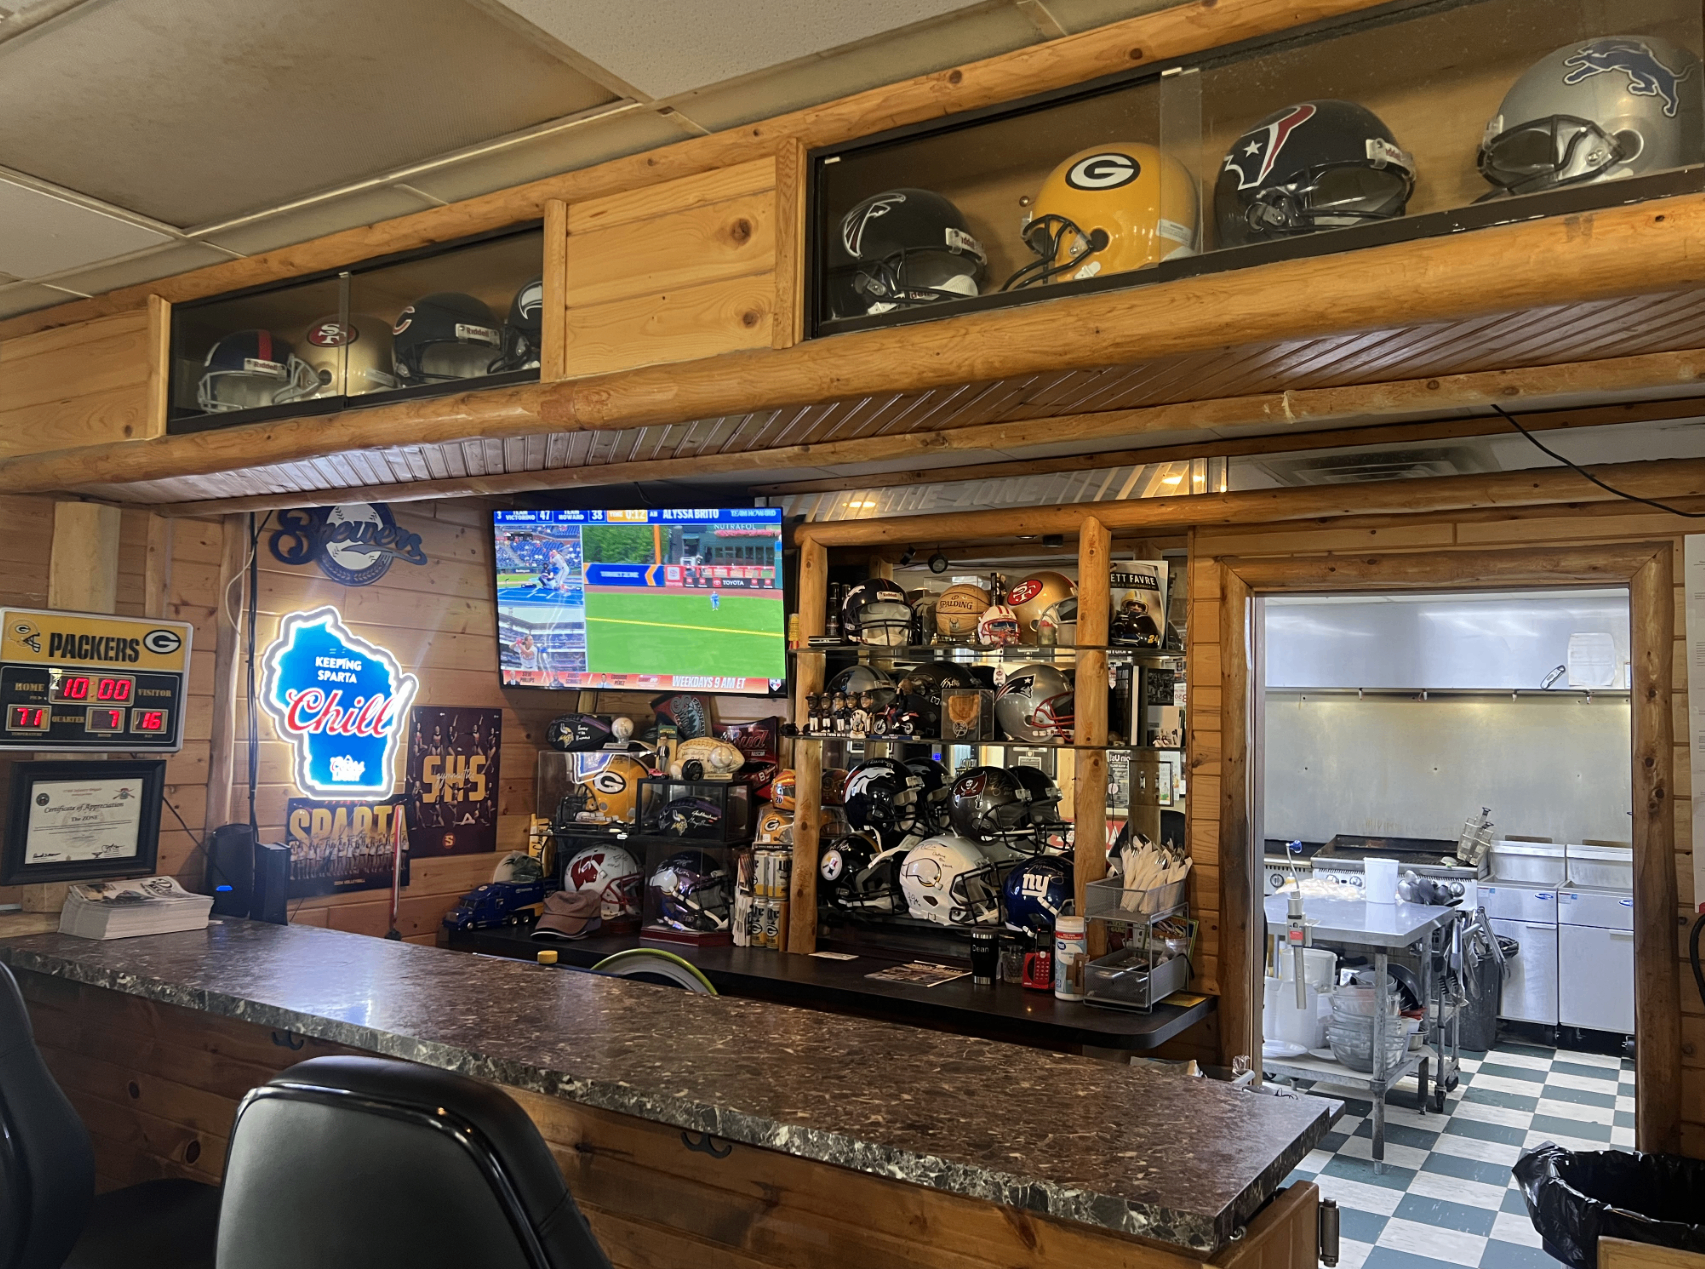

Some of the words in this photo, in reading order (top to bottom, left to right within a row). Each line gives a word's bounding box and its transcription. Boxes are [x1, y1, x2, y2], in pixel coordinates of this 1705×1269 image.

[466, 327, 490, 337] Riddell
[540, 510, 551, 520] 47
[663, 509, 694, 519] ALYSSA
[695, 509, 719, 518] BRITO
[1130, 574, 1156, 586] FAVRE
[940, 600, 973, 611] SPALDING
[49, 632, 140, 663] PACKERS
[315, 656, 362, 671] KEEPING
[318, 670, 357, 684] SPARTA
[672, 675, 713, 688] WEEKDAYS
[714, 677, 720, 688] 9
[721, 677, 735, 688] AM
[736, 678, 746, 689] ET
[15, 682, 45, 692] HOME
[138, 689, 172, 697] VISITOR
[286, 688, 396, 738] Chill
[142, 712, 162, 730] 16
[422, 755, 486, 803] SHS
[44, 804, 76, 814] Certificate
[76, 804, 83, 812] of
[84, 802, 124, 811] Appreciation
[972, 944, 989, 953] Dean
